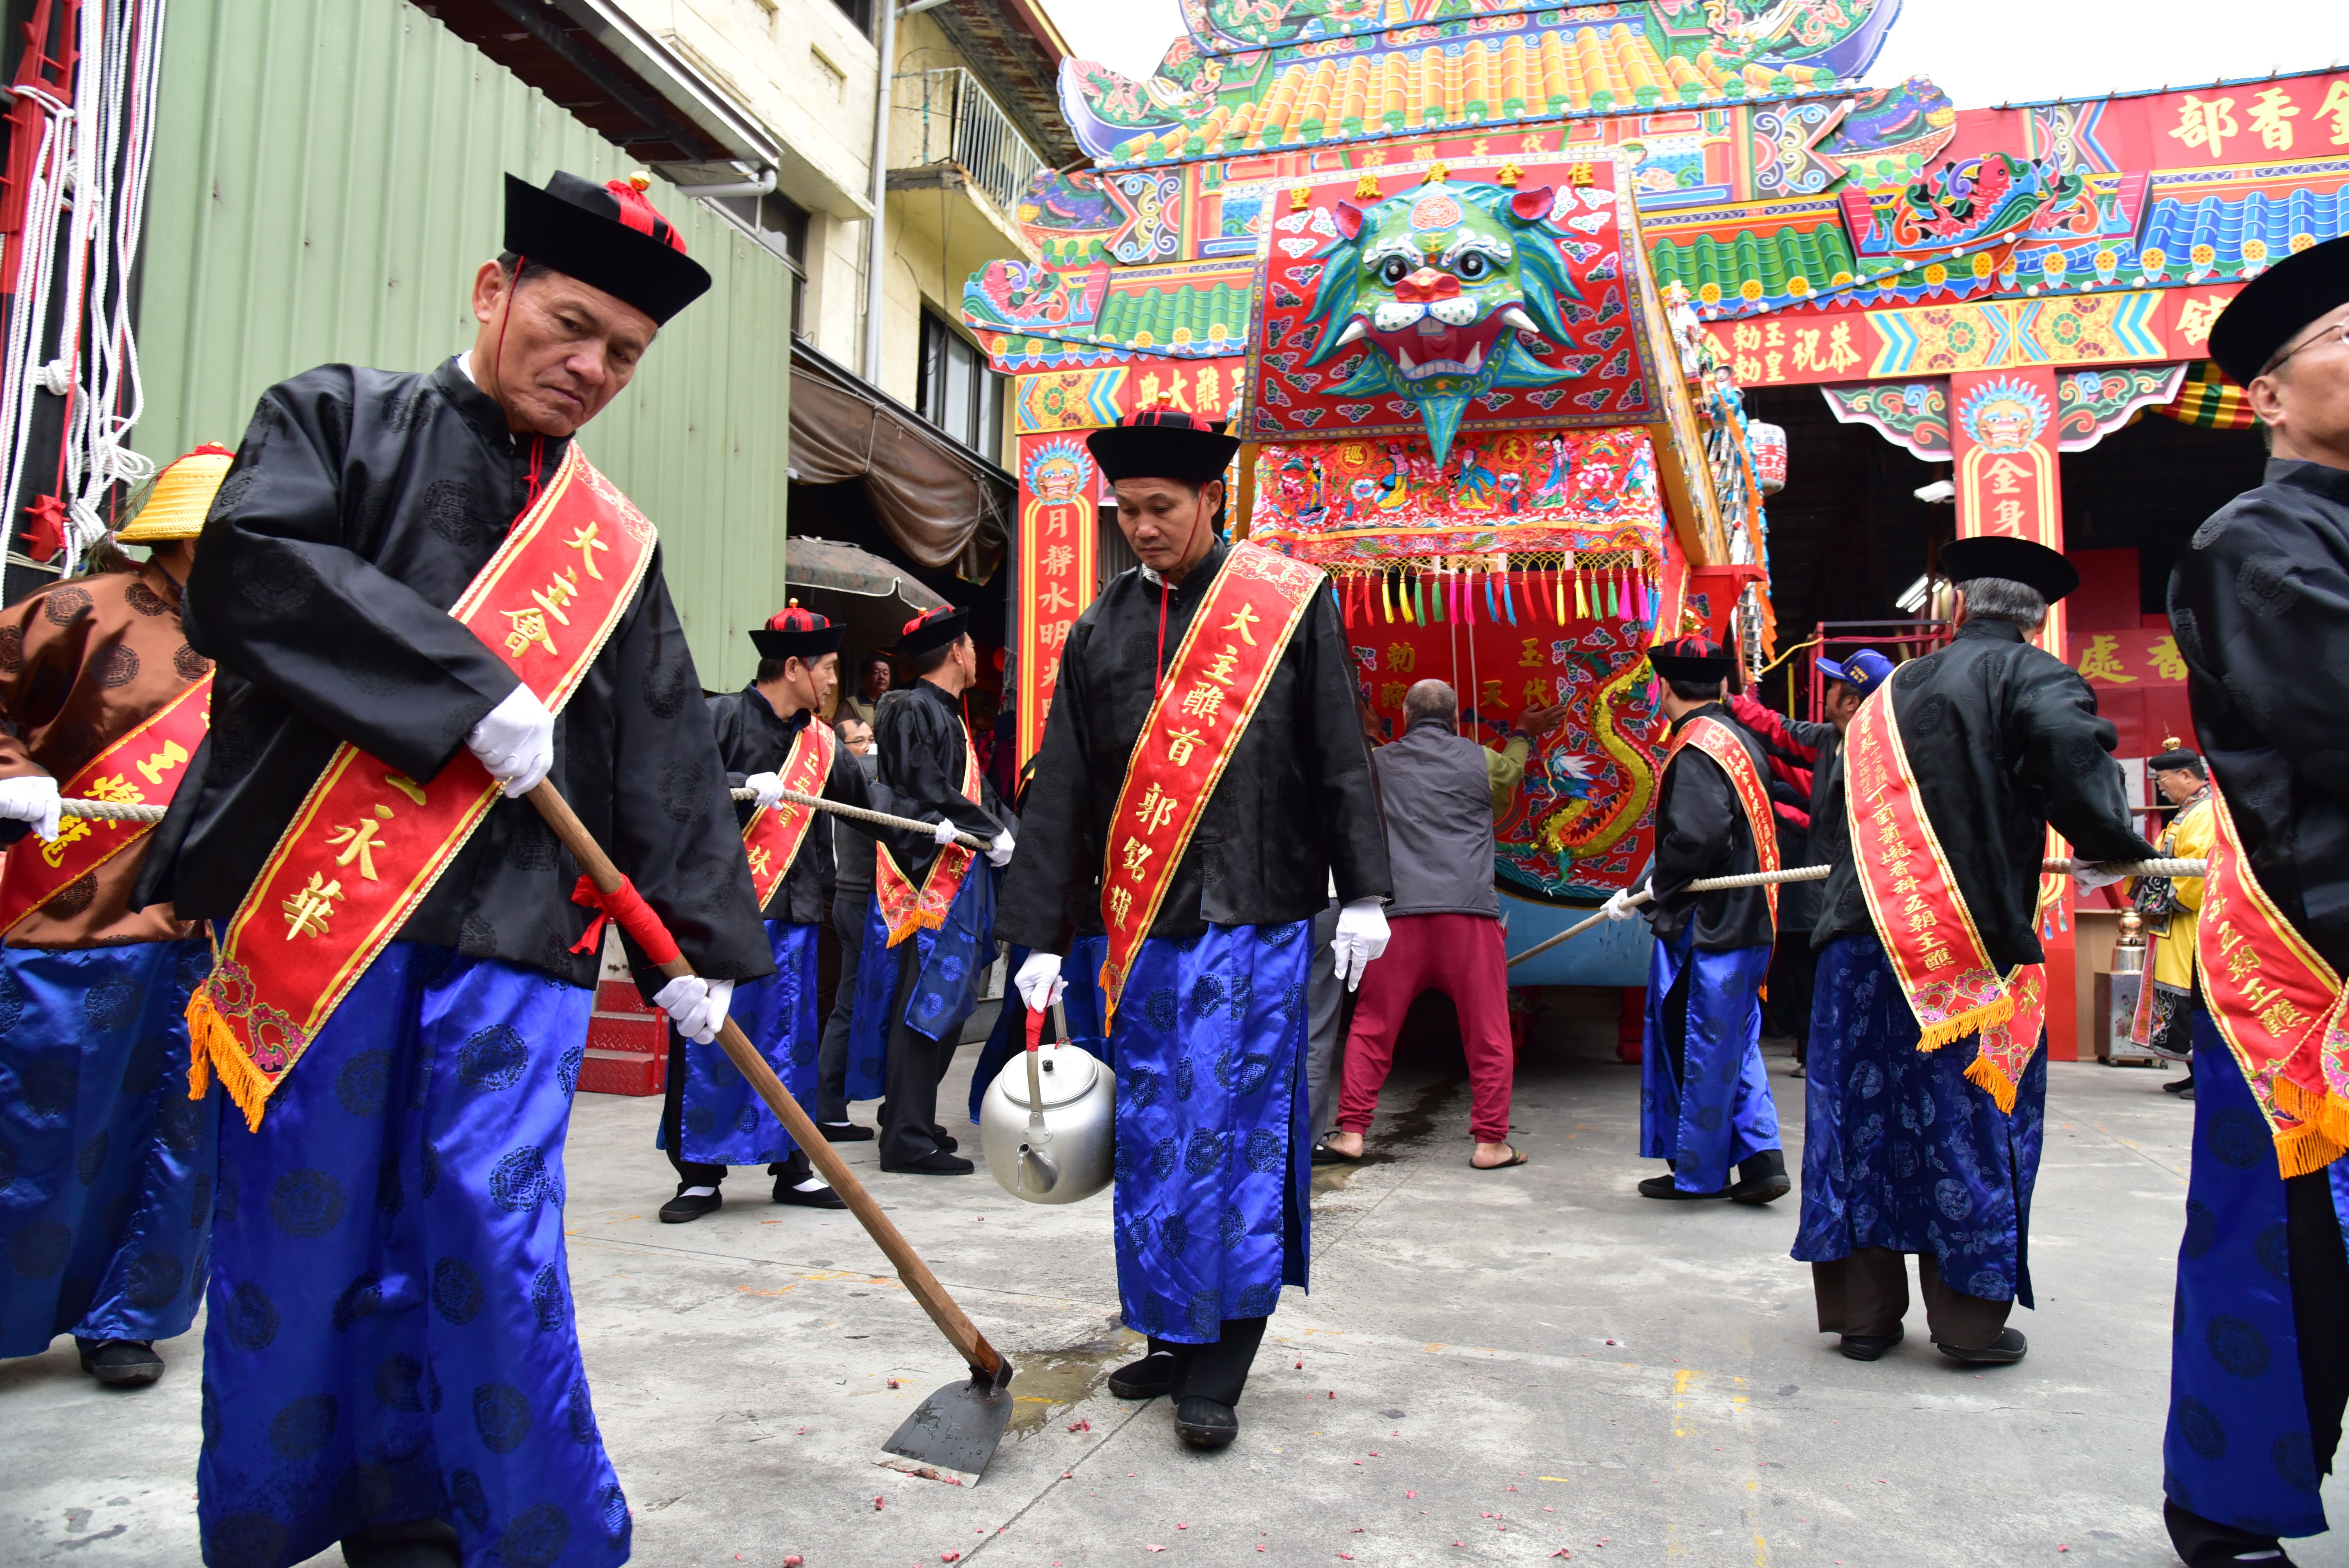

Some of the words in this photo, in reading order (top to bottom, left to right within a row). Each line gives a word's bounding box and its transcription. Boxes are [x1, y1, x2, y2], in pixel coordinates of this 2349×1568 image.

[499, 521, 608, 659] 大主會
[1039, 508, 1075, 727] 月靜水明
